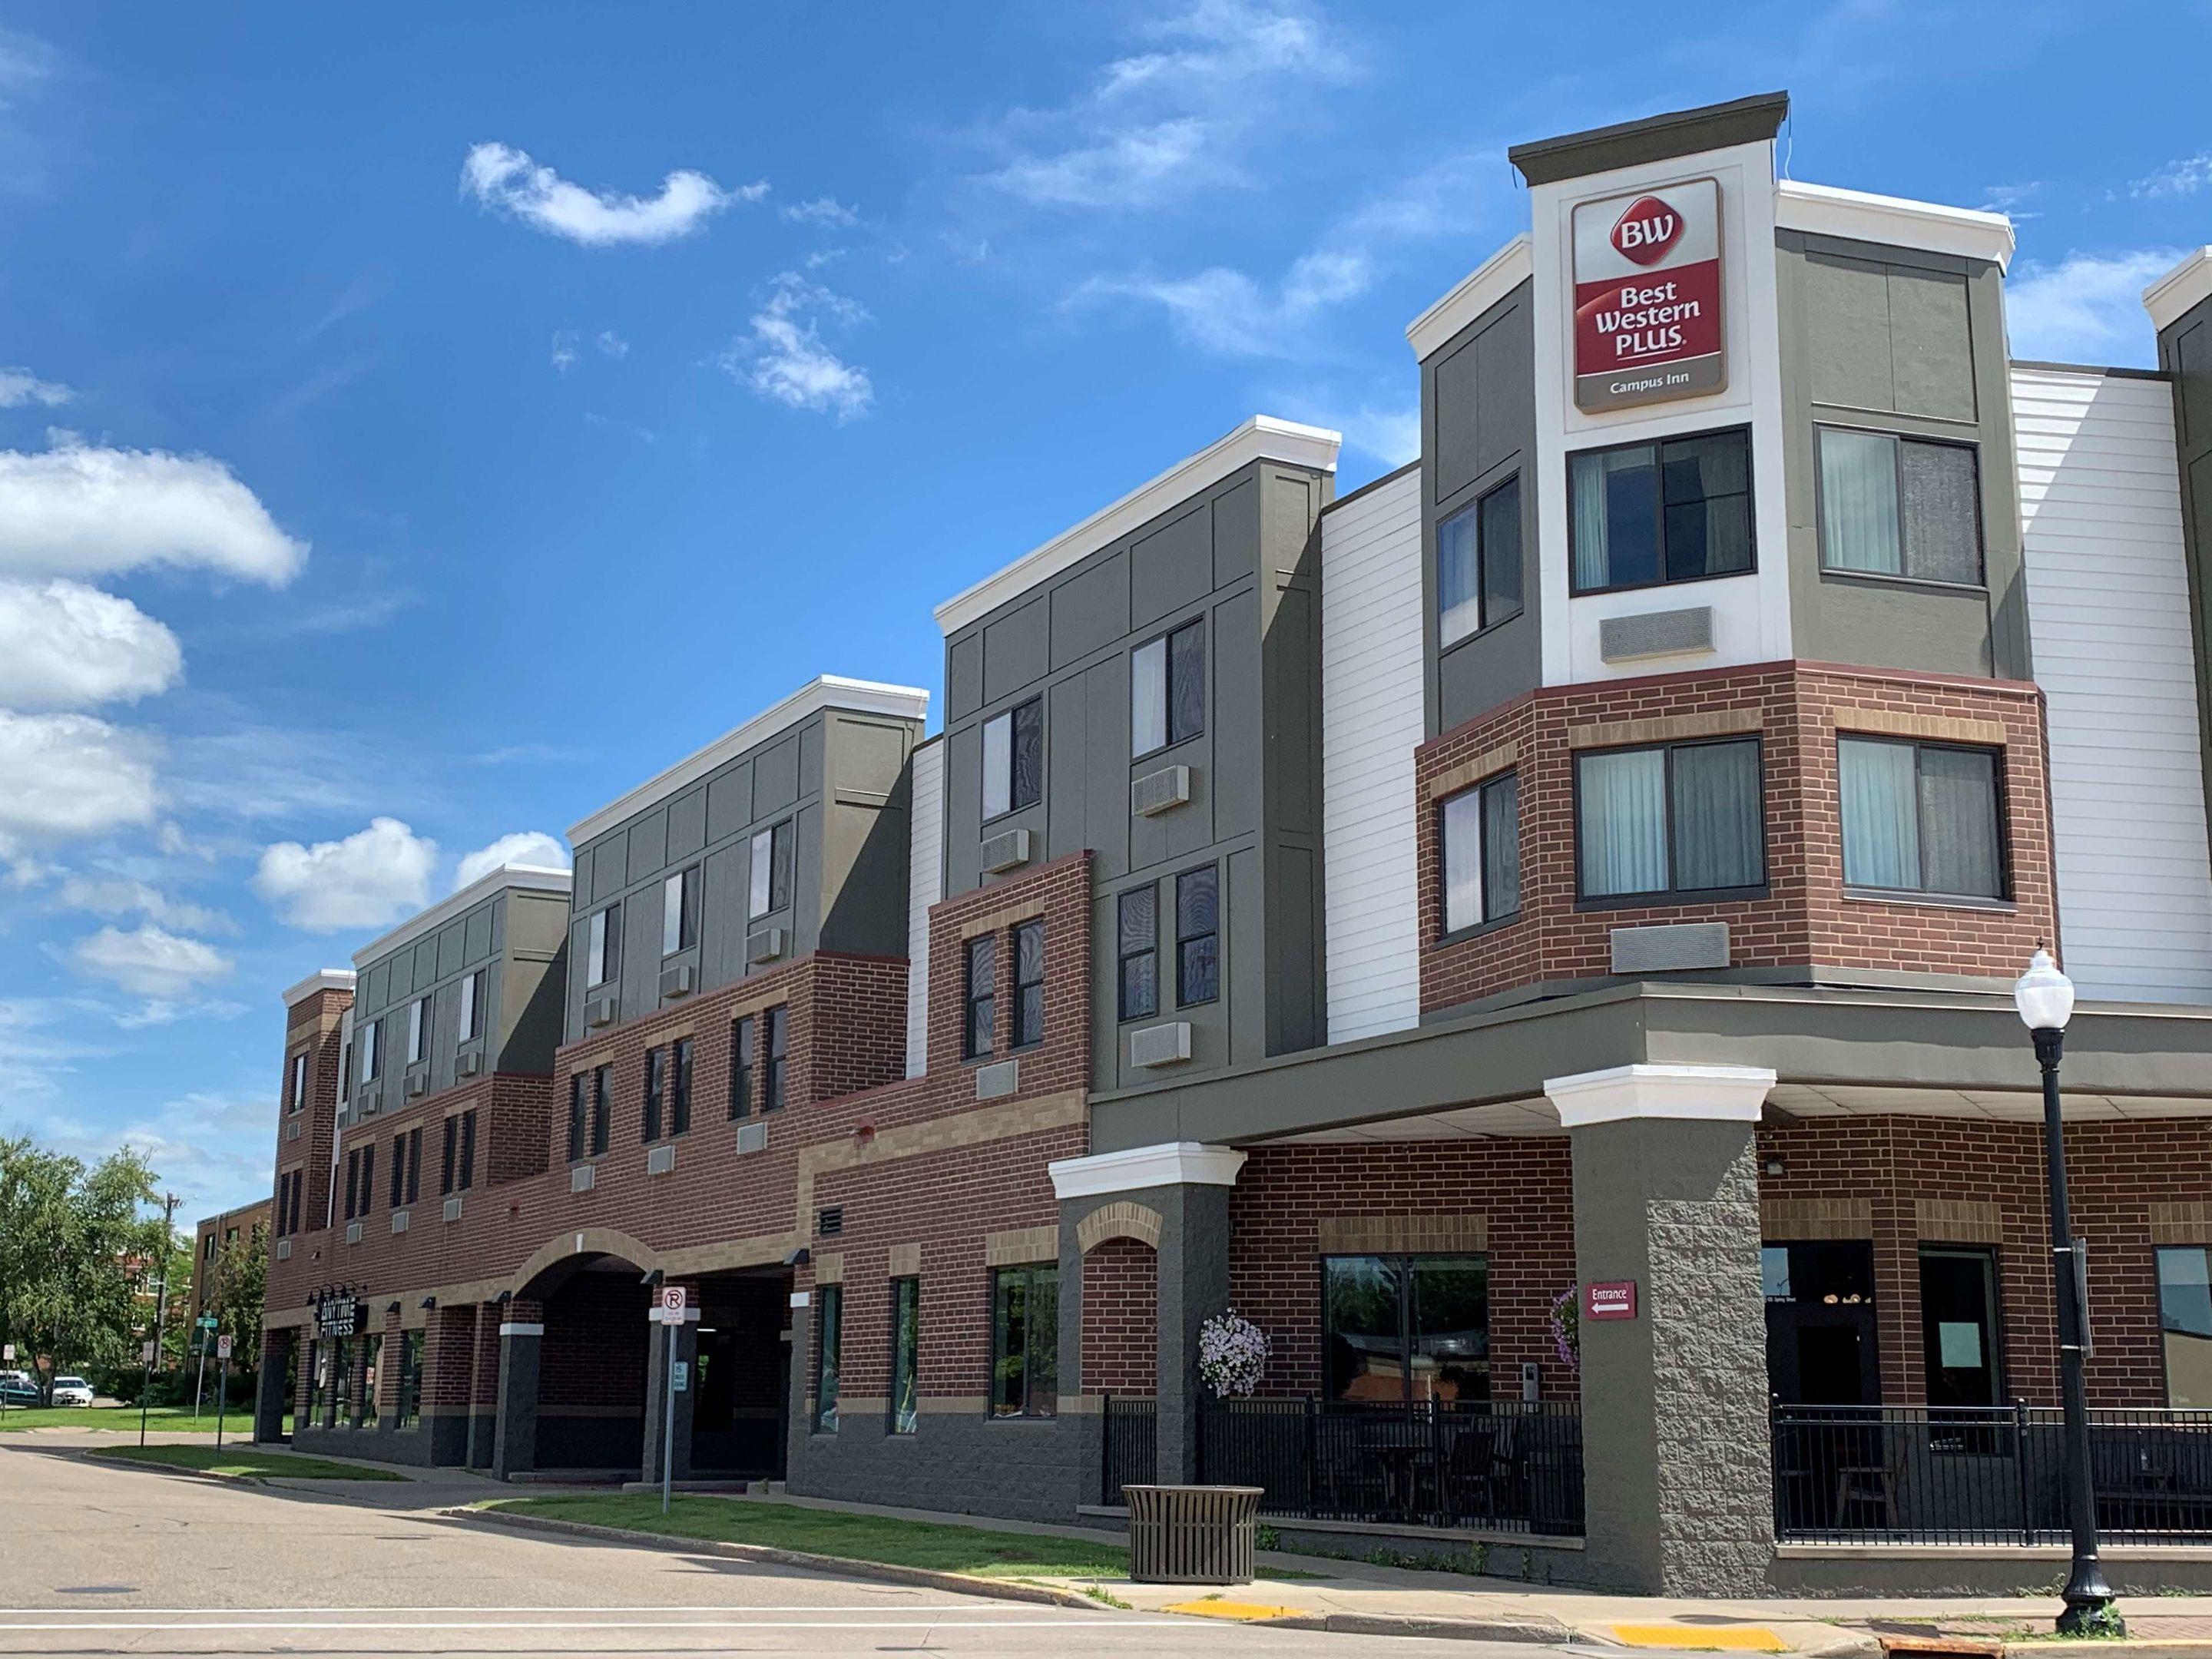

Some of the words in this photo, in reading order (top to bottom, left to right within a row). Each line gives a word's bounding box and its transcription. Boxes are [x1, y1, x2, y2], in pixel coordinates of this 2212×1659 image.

[1621, 214, 1674, 249] BW
[1621, 281, 1677, 309] Best
[1595, 300, 1700, 334] Western
[1610, 377, 1664, 394] Campus
[1667, 373, 1690, 385] Inn
[1592, 1289, 1628, 1300] Entrance
[321, 1319, 354, 1336] FITNESS
